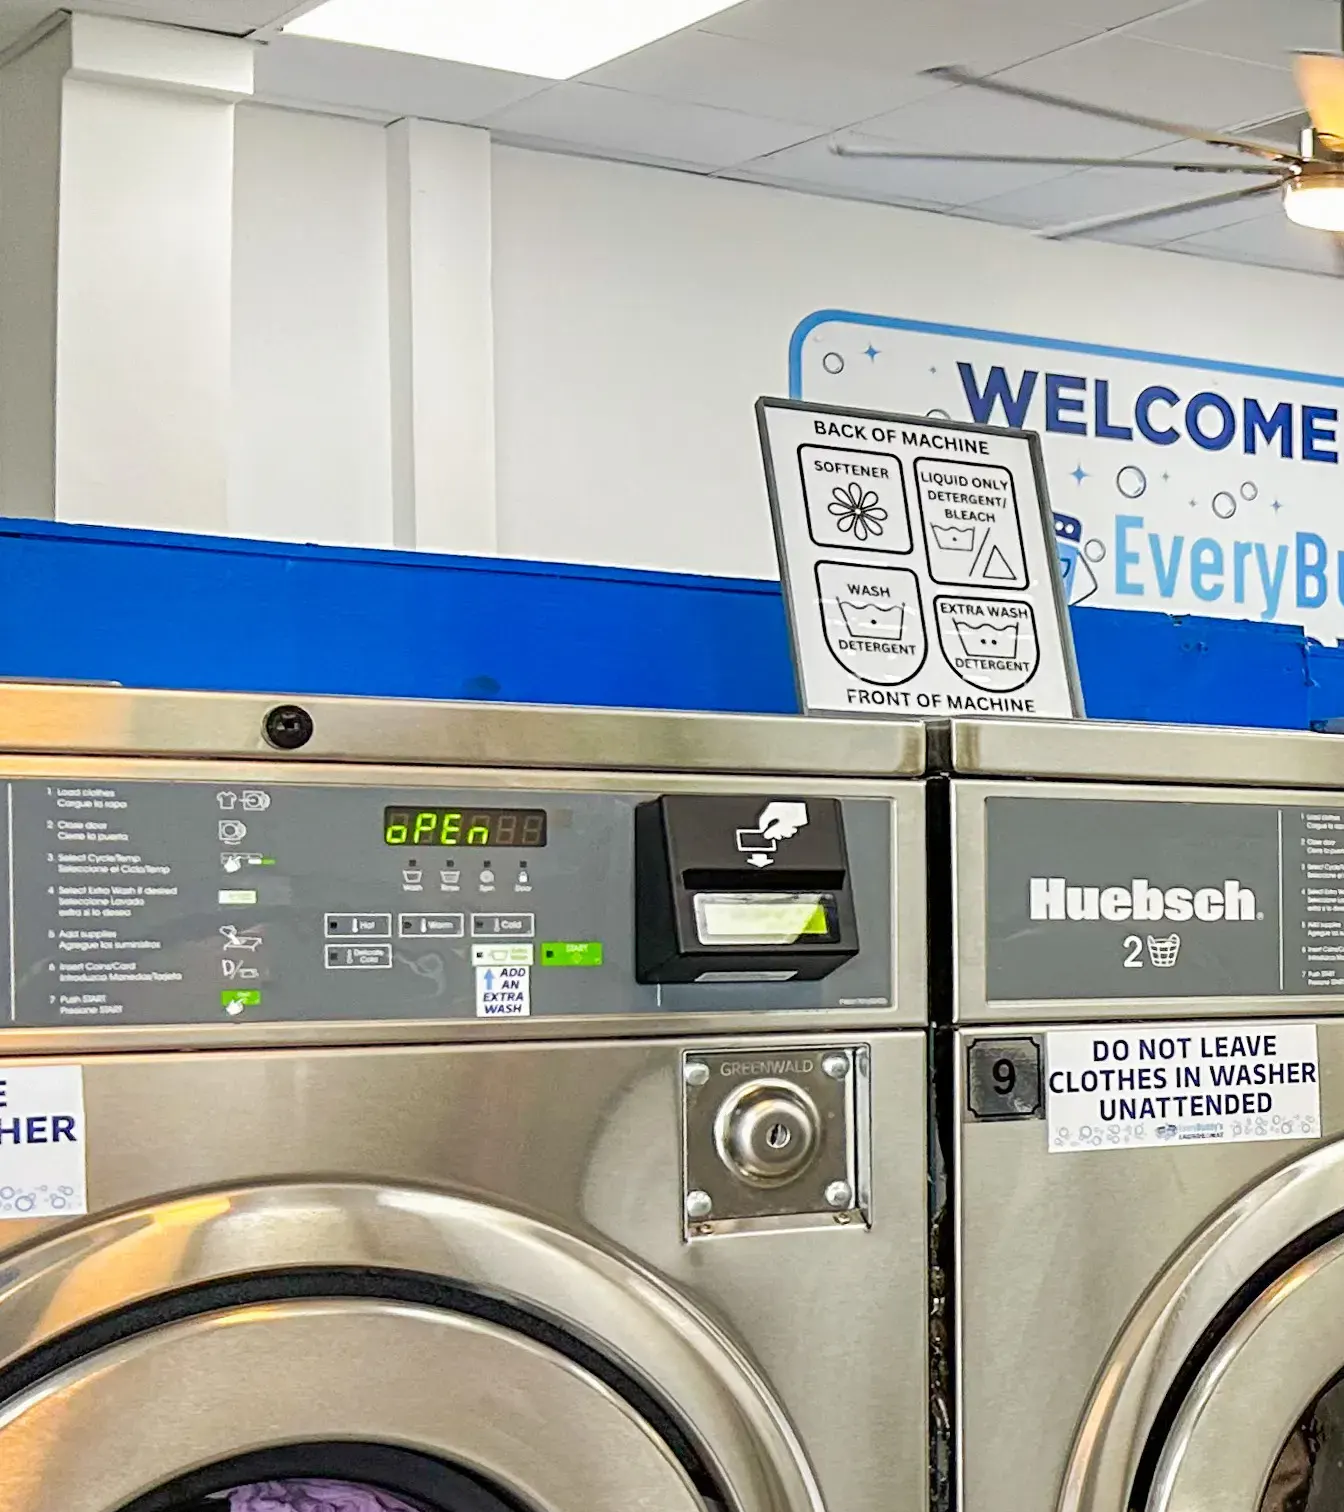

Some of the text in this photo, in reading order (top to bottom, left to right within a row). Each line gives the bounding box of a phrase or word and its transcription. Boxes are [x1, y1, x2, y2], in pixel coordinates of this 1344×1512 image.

[956, 360, 1339, 464] WELCOME
[815, 420, 990, 454] BACK OF MACHINE
[814, 460, 889, 479] SOFTENER
[921, 472, 1008, 491] LIQUID ONLY
[928, 490, 1007, 509] DETERGENT/
[945, 509, 995, 523] BLEACH
[848, 584, 890, 598] WASH
[941, 603, 1028, 618] EXTRA WASH
[839, 639, 916, 656] DETERGENT
[955, 658, 1030, 673] DETERGENT
[847, 688, 1036, 713] FRONT OF MACHINE
[1030, 877, 1256, 921] Huebsch
[1123, 935, 1143, 968] 2
[500, 968, 526, 978] ADD
[502, 980, 519, 989] AN
[483, 992, 524, 1002] EXTRA
[485, 1003, 522, 1014] WASH
[1093, 1035, 1277, 1062] DO NOT LEAVE
[720, 1057, 813, 1078] GREENWALD
[992, 1058, 1016, 1094] 9
[1050, 1062, 1316, 1094] CLOTHES IN WASHER
[1100, 1093, 1272, 1120] UNATTENDED
